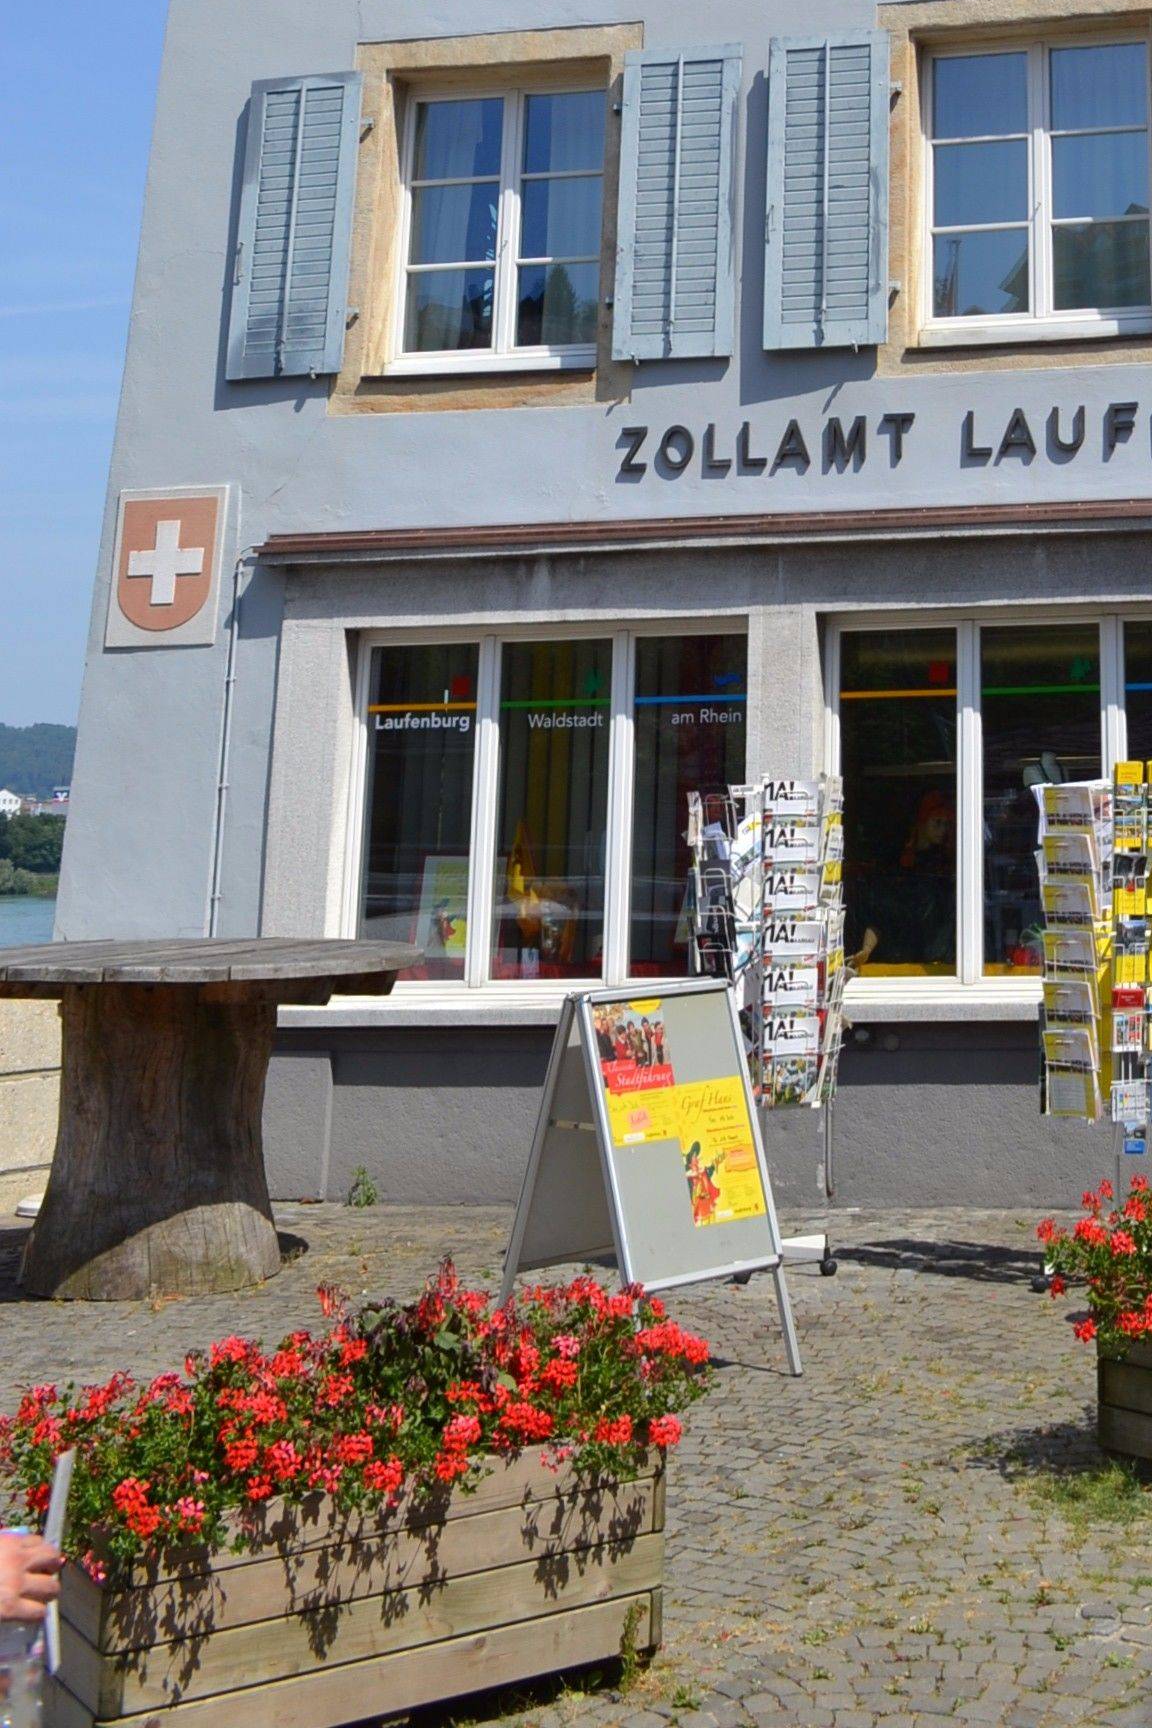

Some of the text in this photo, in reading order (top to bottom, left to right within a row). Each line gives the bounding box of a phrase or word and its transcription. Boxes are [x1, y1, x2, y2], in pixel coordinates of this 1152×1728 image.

[620, 412, 915, 472] ZOLLAMT
[375, 712, 471, 733] Laufenburg
[527, 712, 604, 729] Waldstadt
[671, 709, 742, 725] am Rhein
